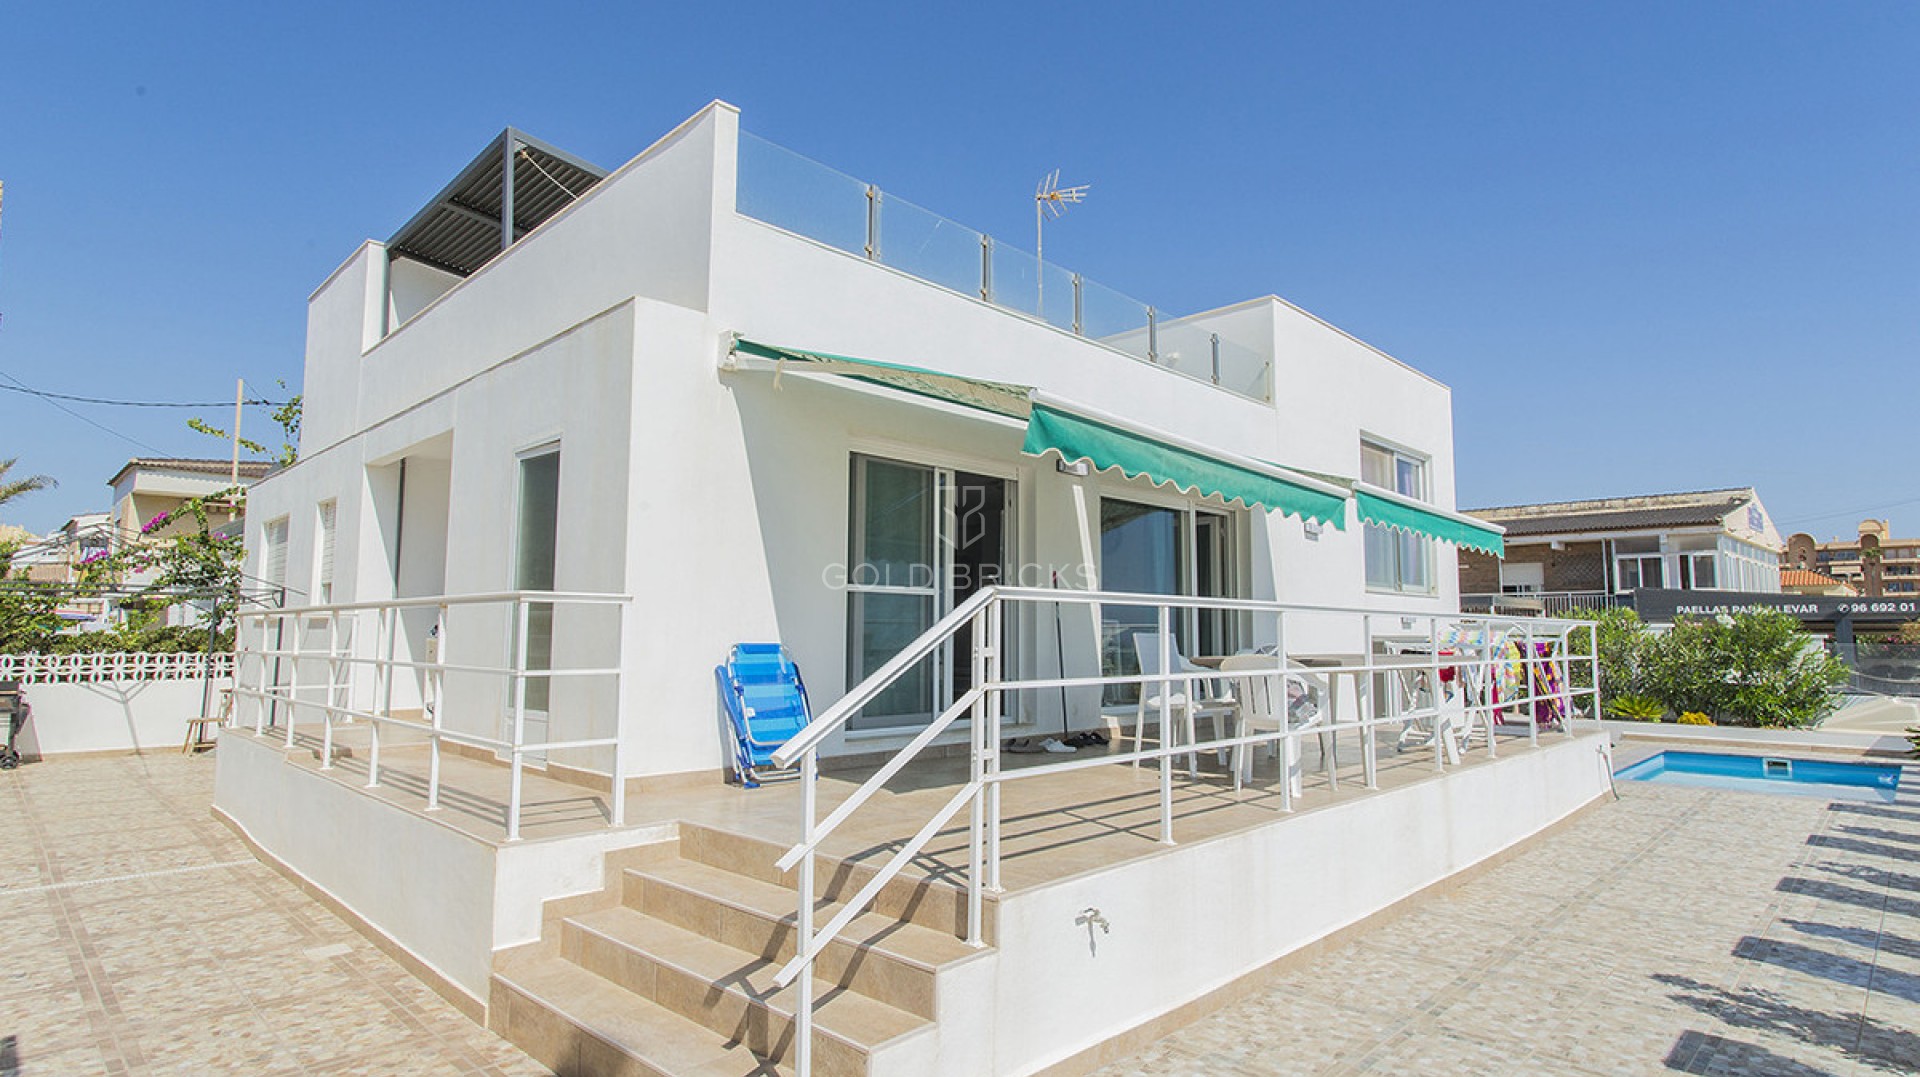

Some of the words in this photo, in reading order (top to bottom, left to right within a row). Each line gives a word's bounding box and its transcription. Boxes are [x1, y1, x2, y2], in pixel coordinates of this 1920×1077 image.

[1732, 605, 1766, 616] PA
[1850, 602, 1868, 613] 96
[1870, 602, 1896, 612] 692
[1899, 602, 1916, 612] 01
